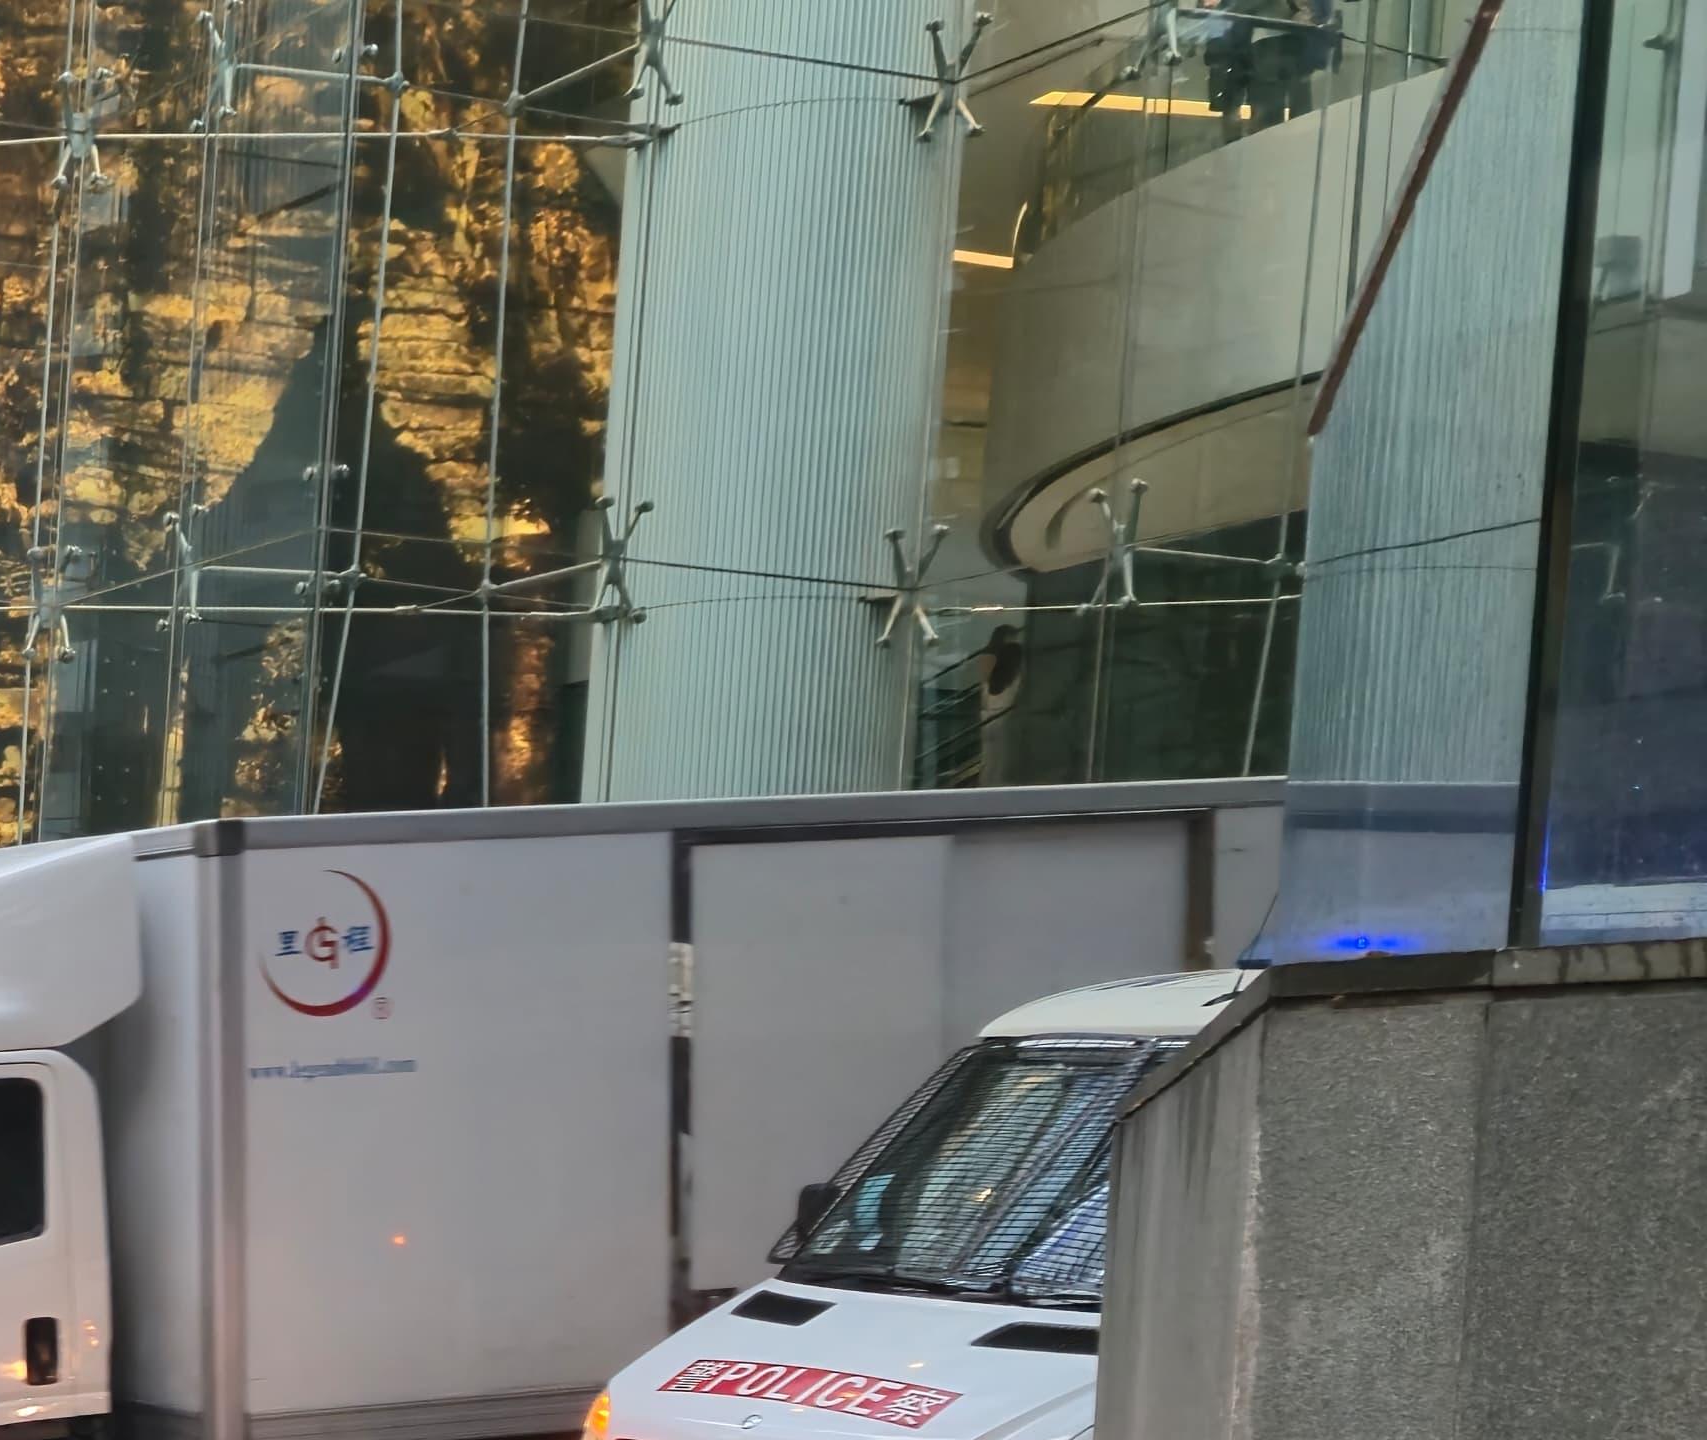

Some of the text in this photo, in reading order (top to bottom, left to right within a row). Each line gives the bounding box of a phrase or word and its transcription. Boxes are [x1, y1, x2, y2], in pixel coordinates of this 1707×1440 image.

[671, 1360, 949, 1426] 警 POLICE 察
